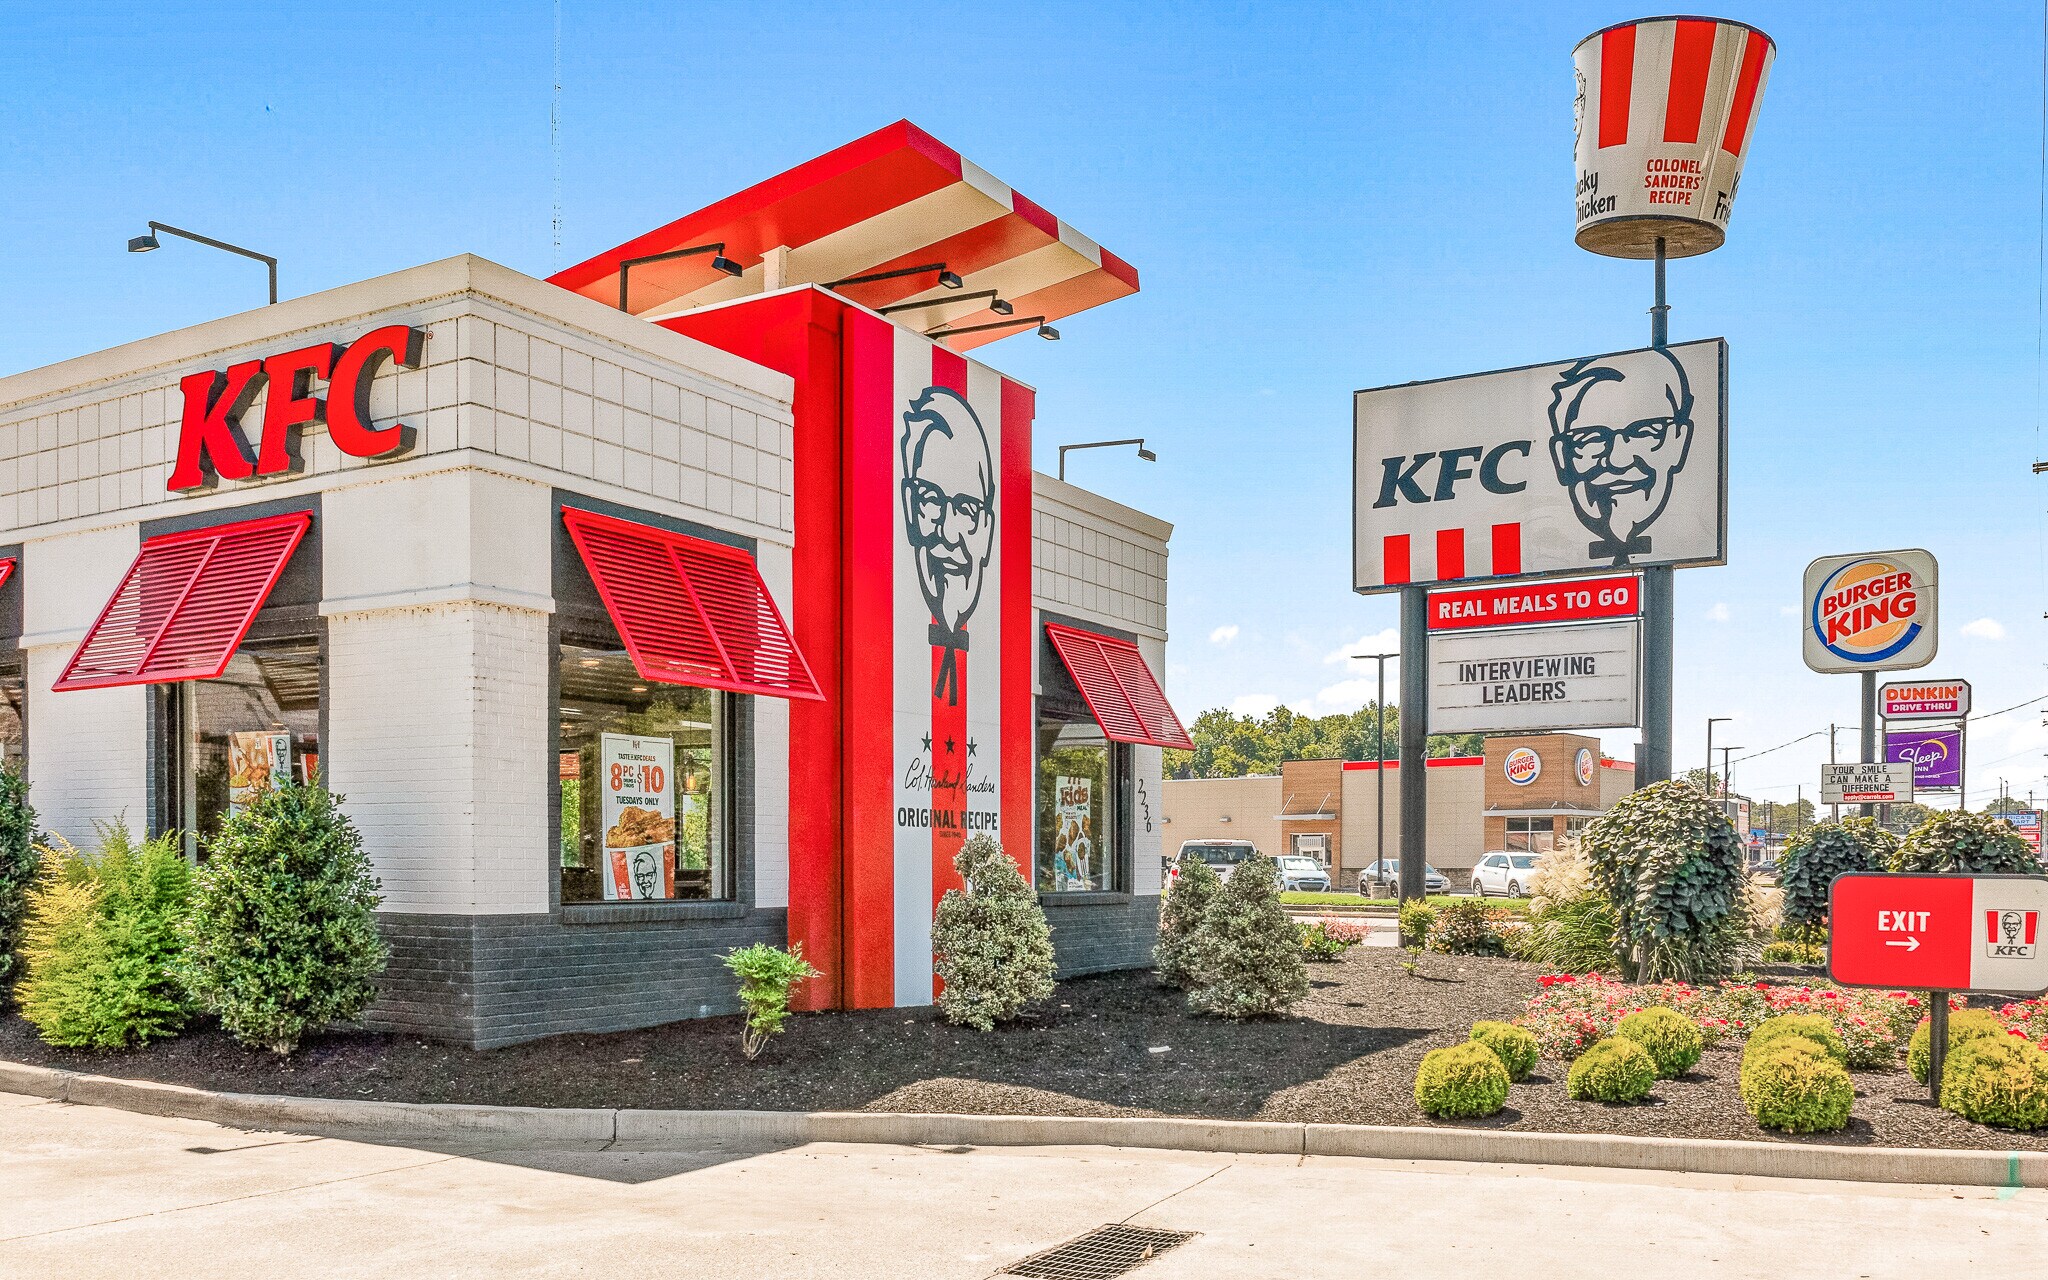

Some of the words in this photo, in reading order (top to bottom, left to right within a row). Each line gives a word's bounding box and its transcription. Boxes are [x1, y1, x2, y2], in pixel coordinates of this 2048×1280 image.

[1646, 158, 1702, 175] COLONEL
[1644, 174, 1705, 191] SANDERS'
[1649, 190, 1693, 206] RECIPE
[1576, 193, 1617, 224] hicken
[167, 324, 414, 492] KFC
[1372, 440, 1533, 509] KFC
[1438, 599, 1488, 619] REAL
[1492, 593, 1558, 616] MEALS
[1563, 590, 1592, 610] TO
[1597, 587, 1629, 606] GO
[1823, 571, 1912, 618] BURGER
[1826, 591, 1917, 646] KING
[1459, 656, 1596, 682] INTERVIEWING
[1482, 681, 1567, 705] LEADERS
[1885, 685, 1963, 701] DUNKIN'
[1892, 703, 1922, 712] DRIVE
[1924, 702, 1952, 711] THRU
[618, 752, 630, 760] TASTE
[1508, 755, 1535, 769] BURGER
[1898, 746, 1943, 768] Sleep
[1509, 761, 1535, 777] KING
[1832, 765, 1855, 775] YOUR
[1861, 765, 1887, 774] SMILE
[610, 762, 623, 792] 8
[623, 765, 634, 778] PC
[637, 764, 665, 794] $10
[1830, 775, 1849, 784] CAN
[1854, 774, 1879, 783] MAKE
[1884, 774, 1892, 782] A
[1060, 785, 1089, 807] kids
[1841, 783, 1890, 793] DIFFERENCE
[616, 795, 643, 805] TUESDAYS
[644, 797, 660, 806] ONLY
[1844, 793, 1894, 801] apply@carrols.com
[897, 806, 957, 829] ORIGINAL
[960, 810, 998, 831] RECIPE
[1877, 910, 1931, 932] EXIT
[1994, 945, 2028, 956] KFC
